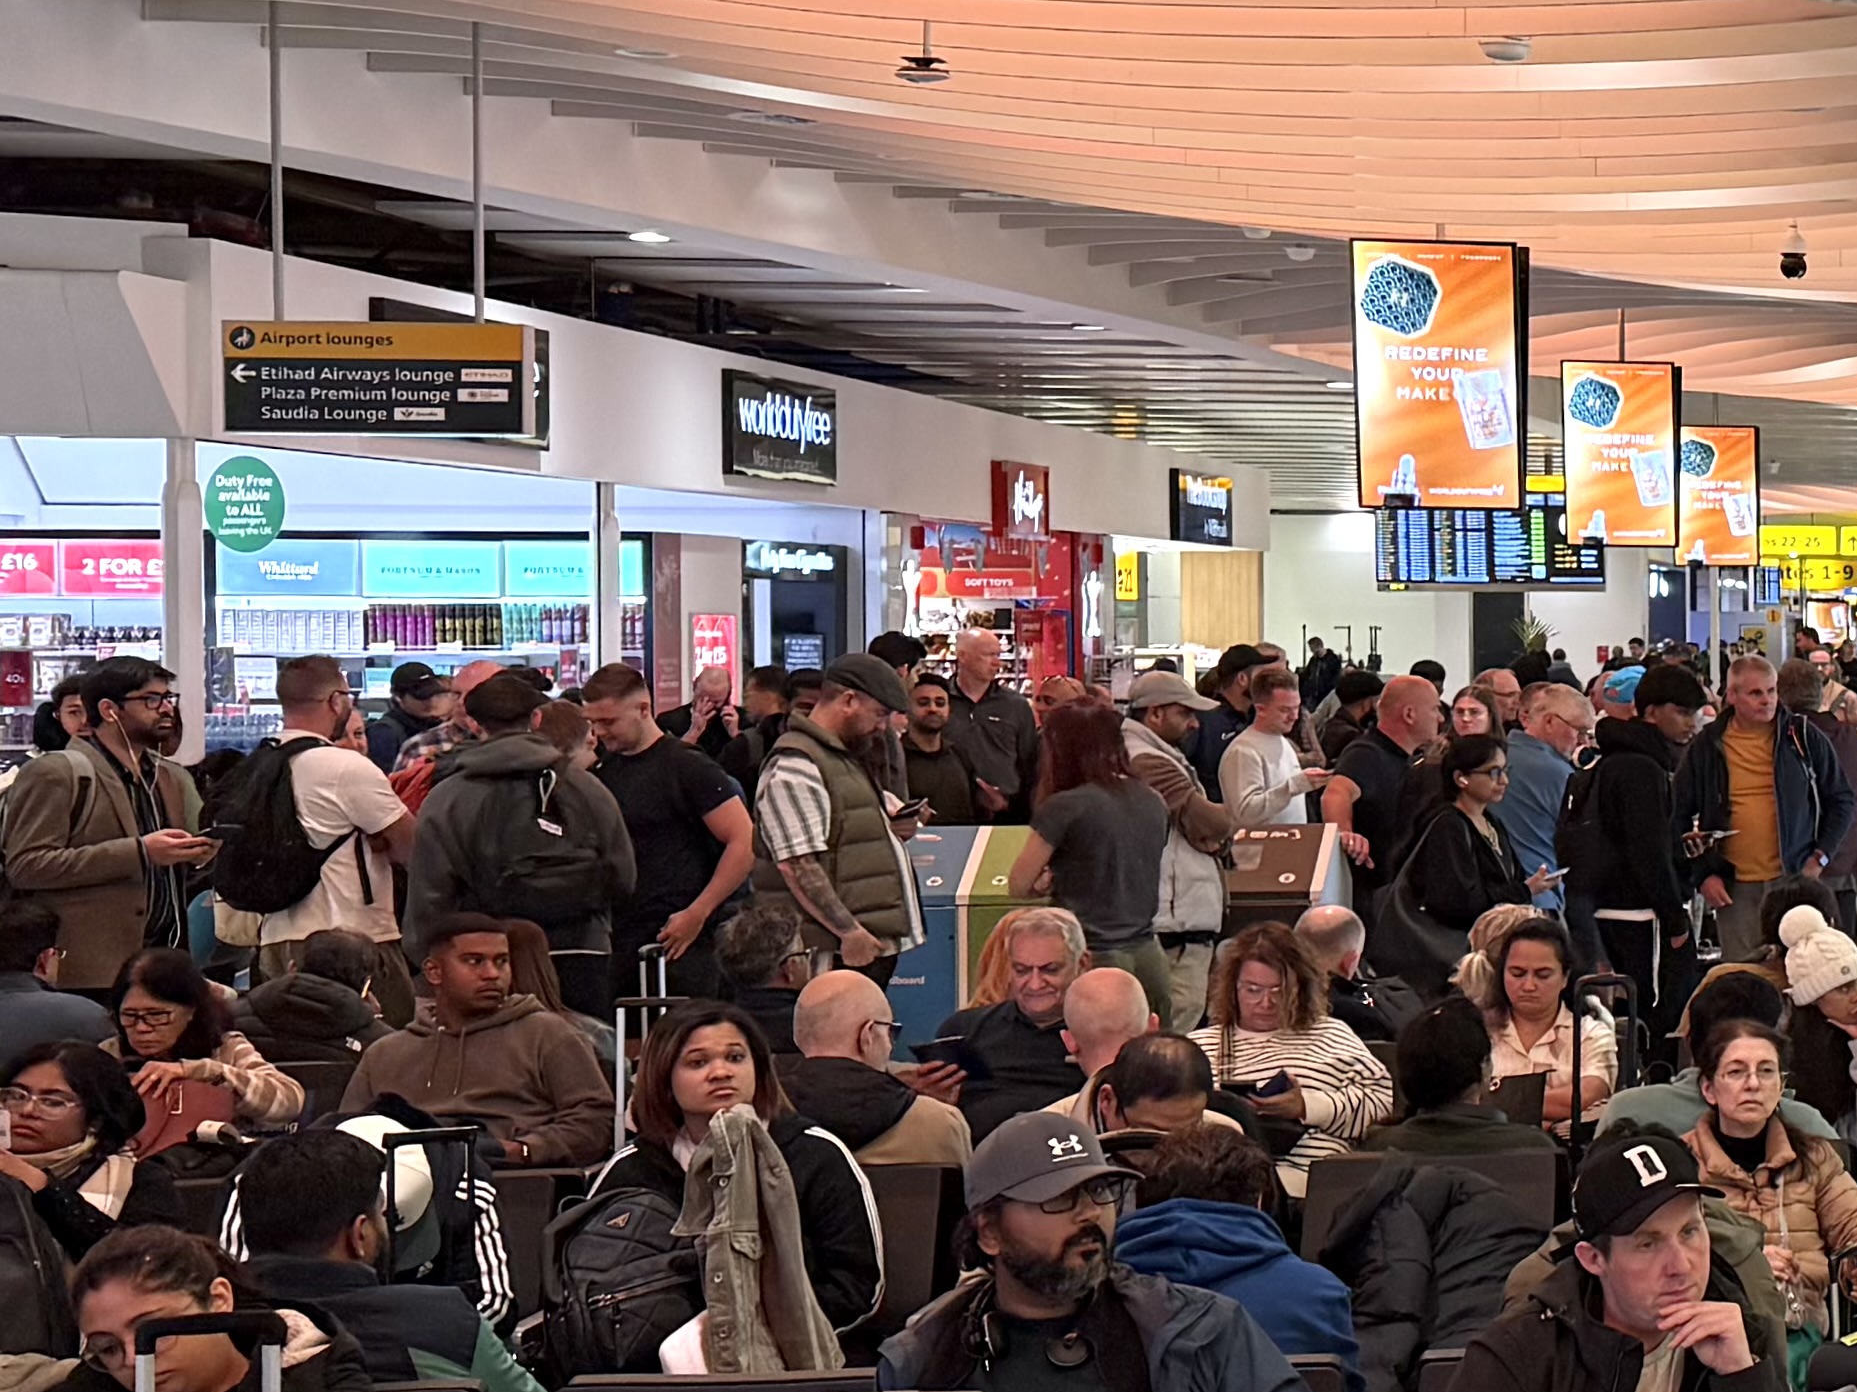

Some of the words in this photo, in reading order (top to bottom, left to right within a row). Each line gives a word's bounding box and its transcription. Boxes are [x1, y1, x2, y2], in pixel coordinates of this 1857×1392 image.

[260, 330, 322, 348] Airport
[326, 331, 394, 349] lounges
[1384, 345, 1489, 362] REDEFINE
[260, 366, 316, 381] Etihad
[320, 366, 391, 385] Airways
[395, 367, 455, 385] lounge
[260, 387, 306, 402] Plaza
[310, 387, 387, 402] Premium
[391, 387, 451, 405] lounge
[1396, 386, 1460, 401] MAKE
[260, 406, 320, 421] Saudia
[324, 406, 388, 424] Lounge
[738, 391, 832, 455] worlddutyfree
[215, 474, 245, 490] Duty
[246, 474, 273, 487] Free
[218, 488, 271, 502] available
[225, 504, 240, 517] to
[240, 503, 264, 516] ALL
[82, 558, 95, 575] 2
[99, 558, 143, 575] FOR
[1822, 565, 1854, 581] 1-9
[1622, 1144, 1668, 1187] D
